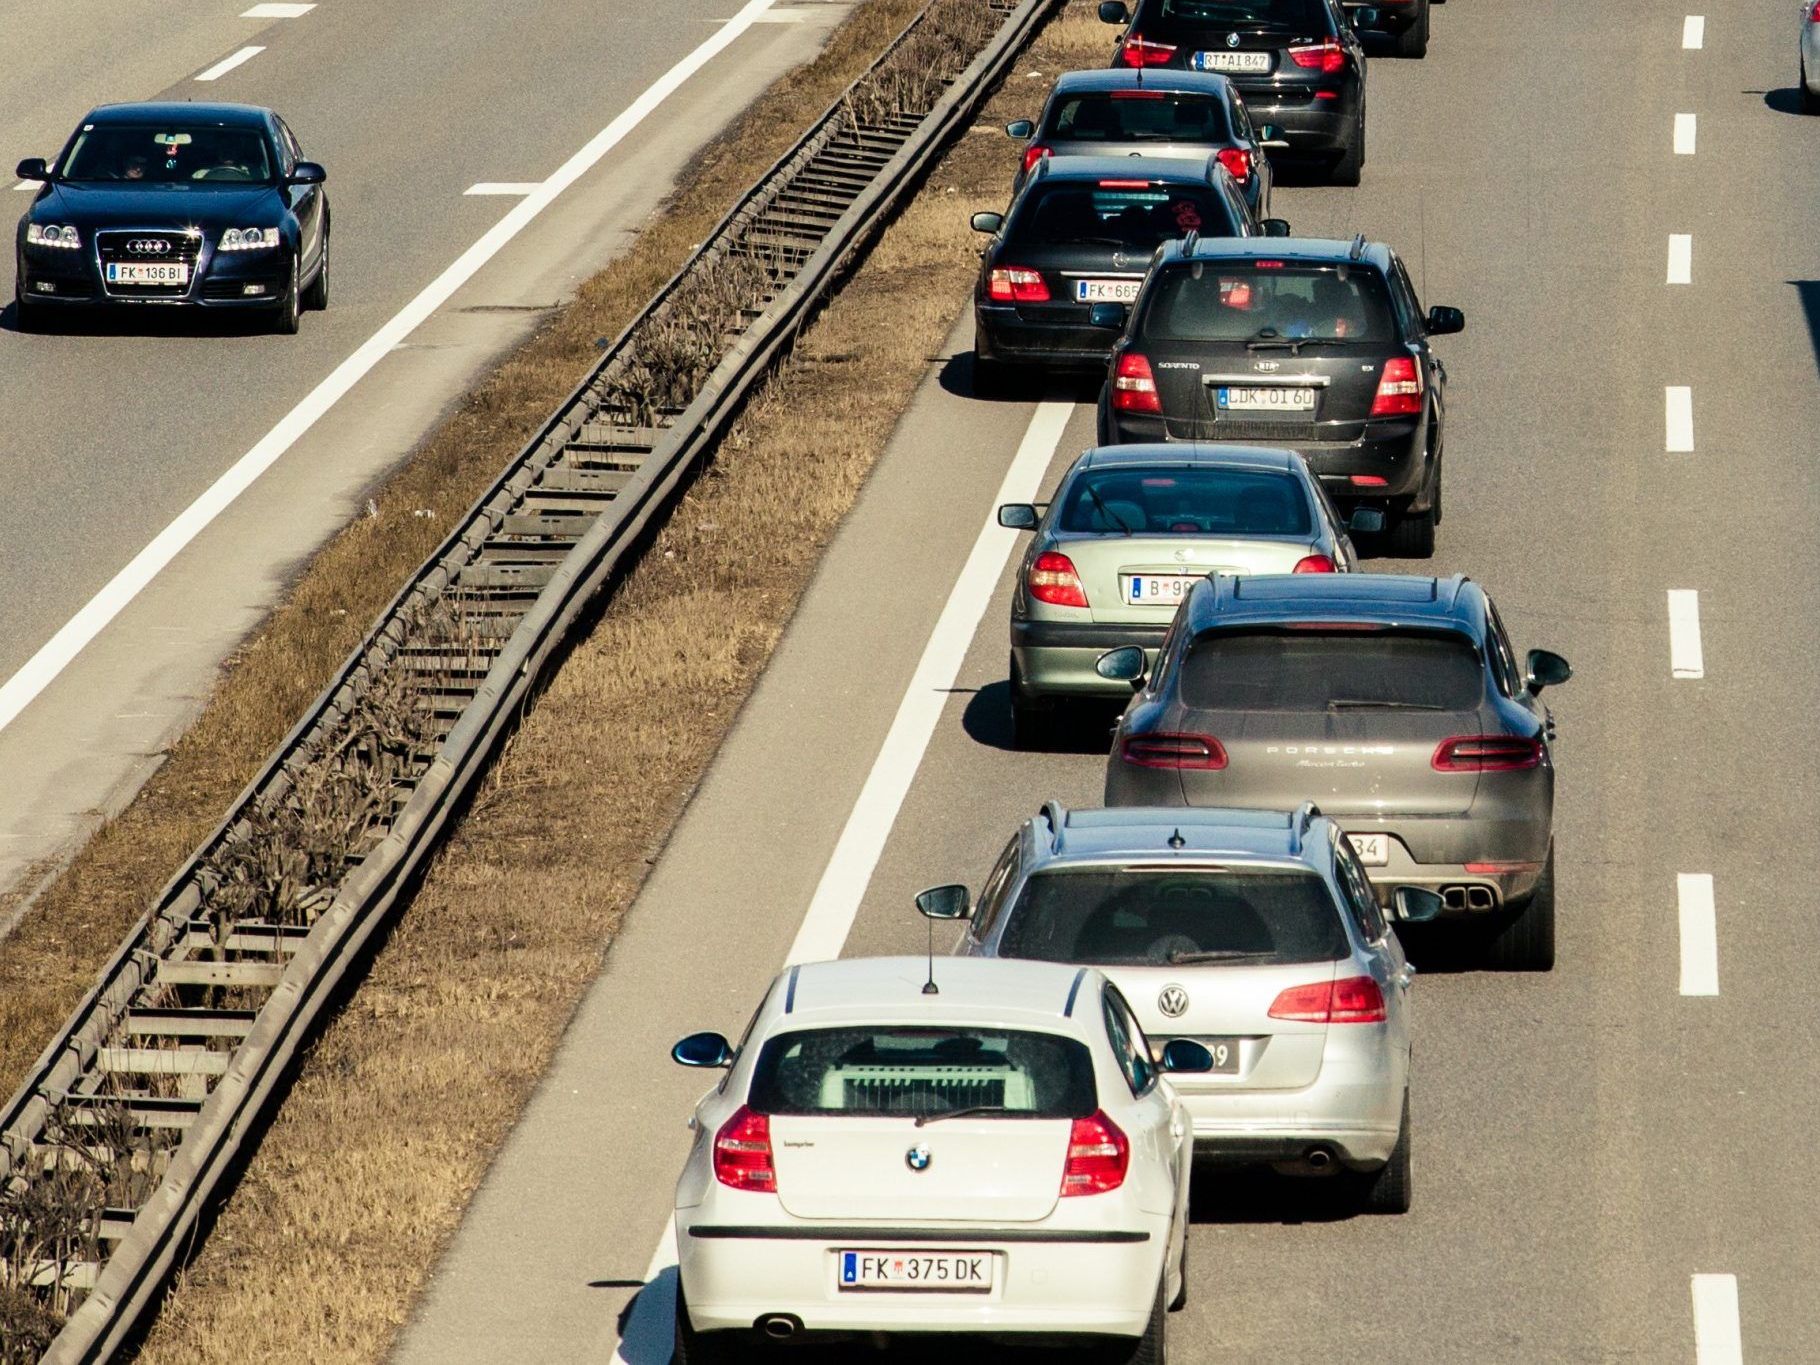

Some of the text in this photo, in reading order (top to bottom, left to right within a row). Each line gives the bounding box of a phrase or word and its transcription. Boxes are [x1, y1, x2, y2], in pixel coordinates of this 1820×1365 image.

[1204, 54, 1220, 67] RT
[1244, 54, 1266, 68] 847
[121, 266, 181, 279] FK 136 BI
[1089, 284, 1105, 297] FK
[1158, 362, 1200, 370] SORENTO
[1228, 388, 1259, 405] LDK
[1150, 580, 1160, 596] B
[1266, 746, 1394, 755] PORSCHE
[862, 1258, 984, 1282] FK 375 DK
